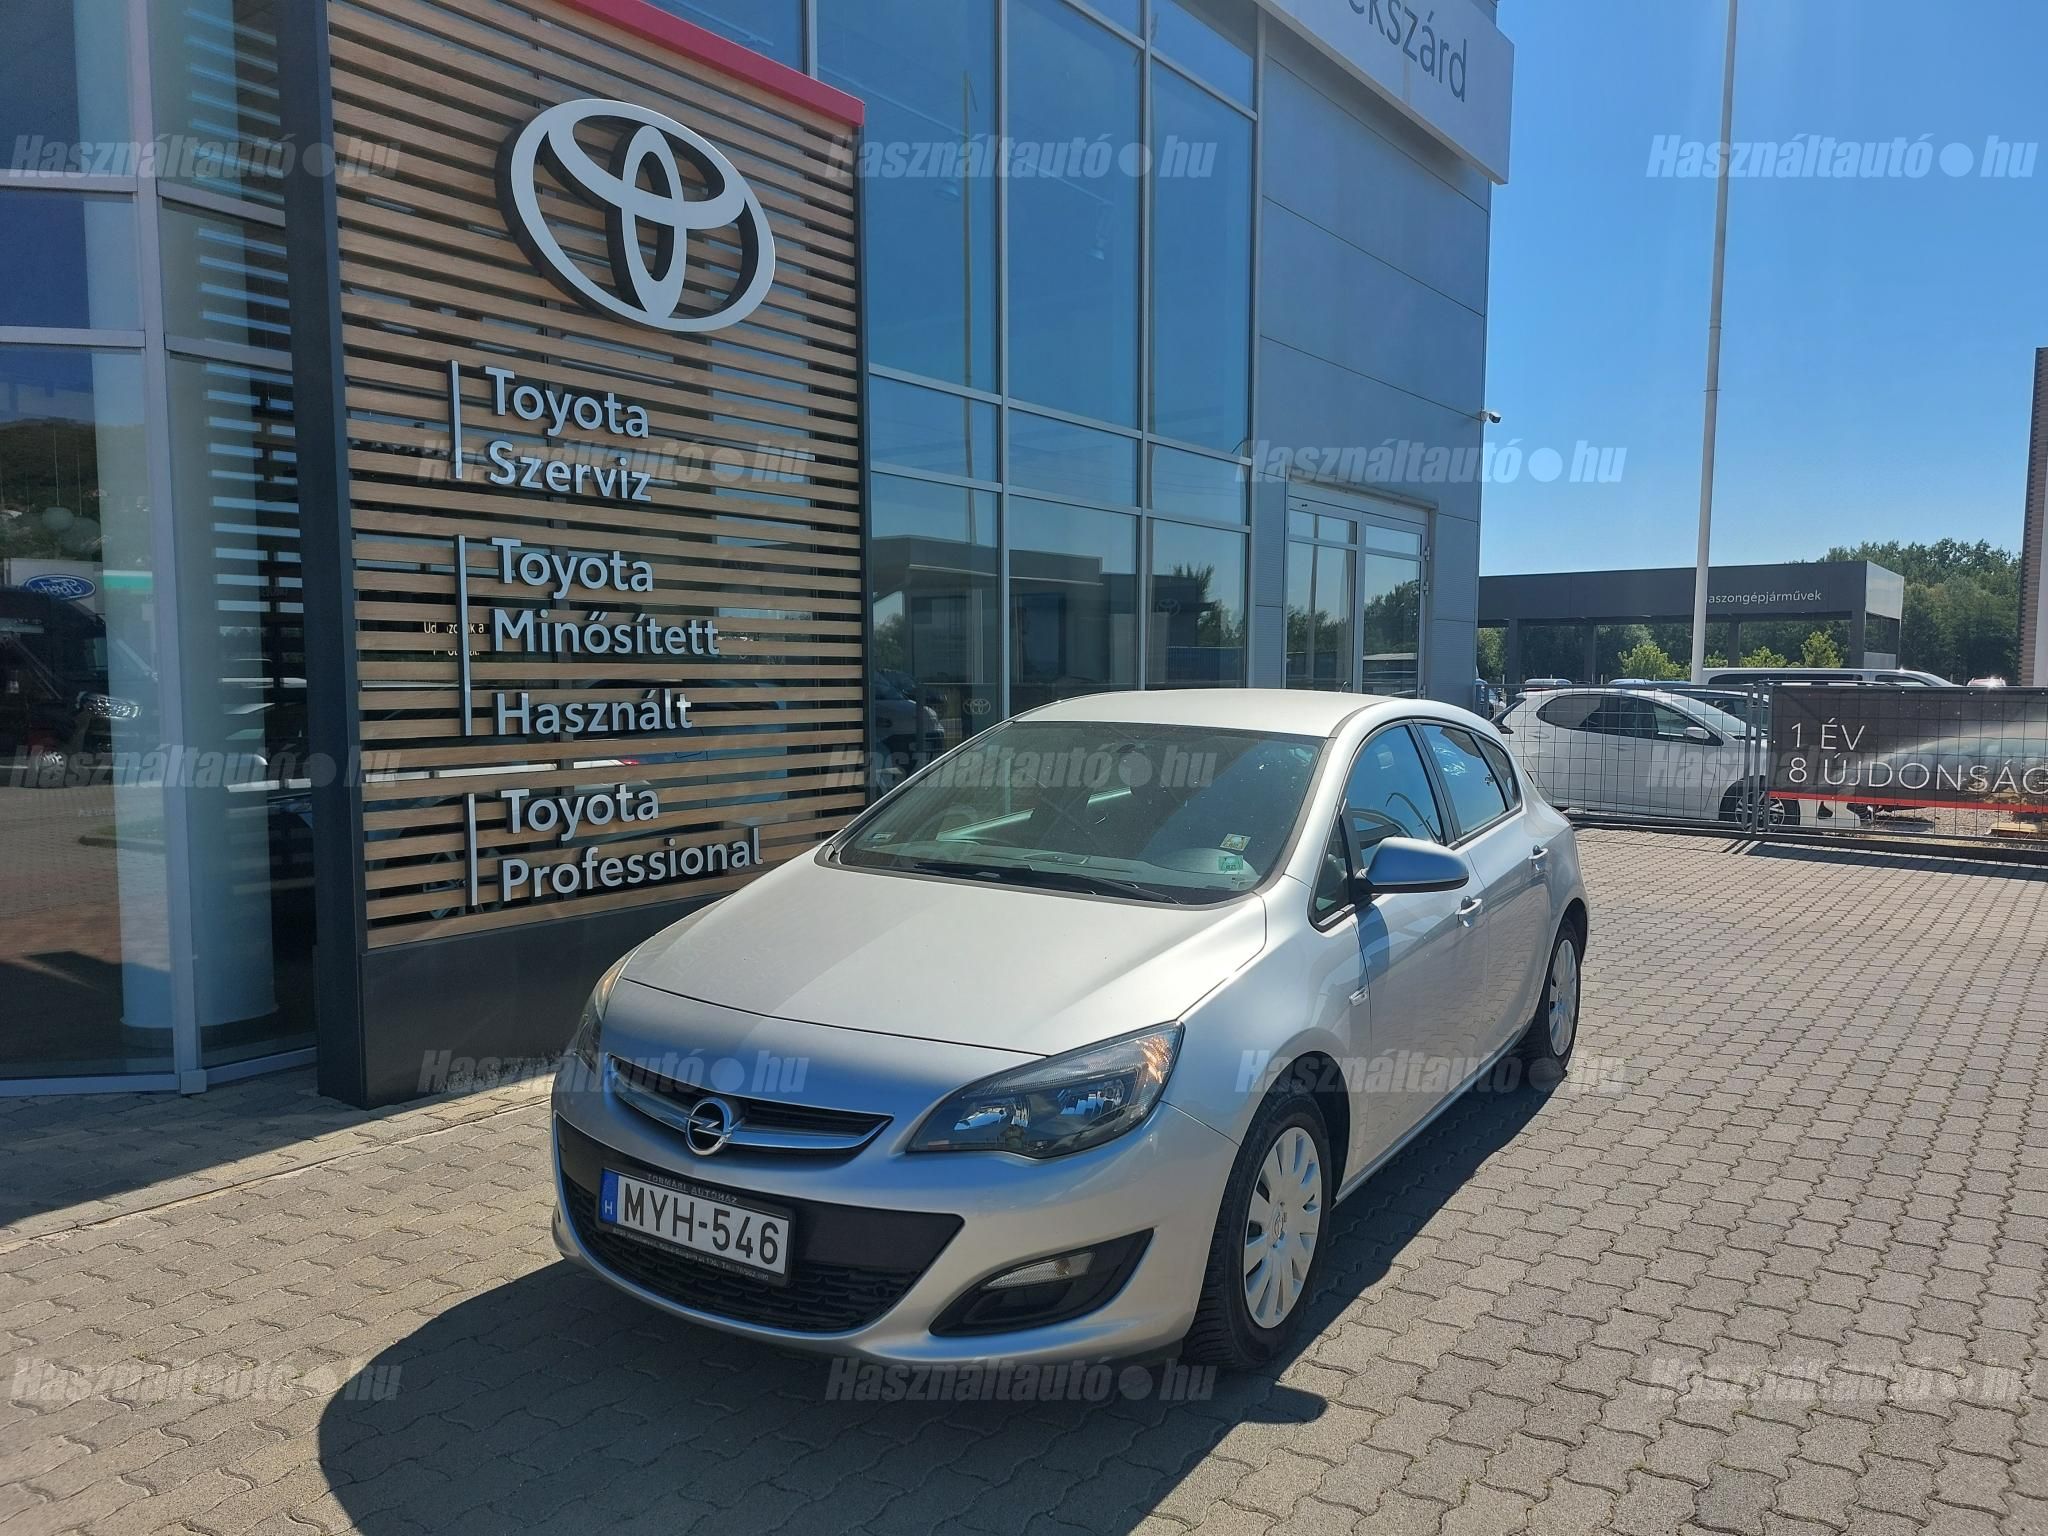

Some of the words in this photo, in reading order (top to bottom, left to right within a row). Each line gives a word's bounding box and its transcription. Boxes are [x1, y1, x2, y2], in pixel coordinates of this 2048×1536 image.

[484, 365, 649, 439] Toyota
[488, 440, 652, 501] Szerviz
[491, 537, 654, 600] Toyota
[1707, 589, 1822, 605] aszongépjárművek
[493, 608, 720, 655] Minősített
[496, 688, 694, 735] Használt
[1791, 722, 1801, 749] 1
[1821, 717, 1865, 751] ÉV
[1788, 757, 1807, 783] 8
[501, 784, 660, 842] Toyota
[502, 827, 764, 902] Professional
[604, 1200, 613, 1215] H
[623, 1183, 780, 1265] MYH-546
